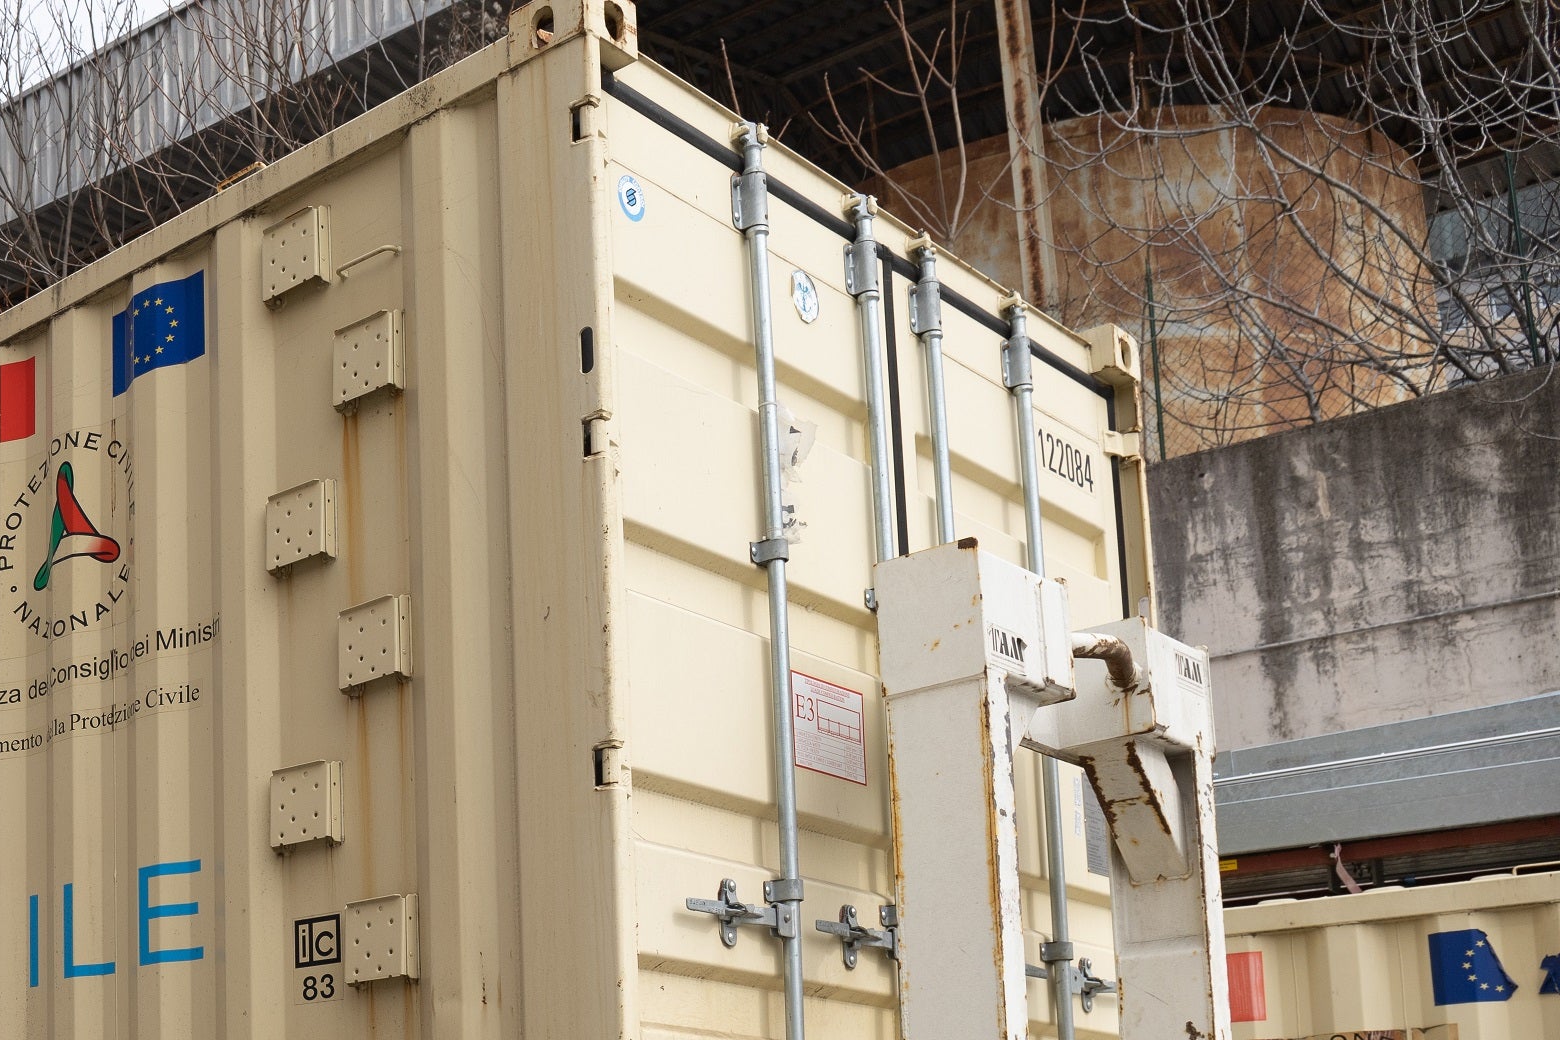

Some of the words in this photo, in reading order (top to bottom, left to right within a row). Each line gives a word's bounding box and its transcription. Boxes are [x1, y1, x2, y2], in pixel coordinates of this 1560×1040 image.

[1037, 428, 1094, 493] 122084
[13, 564, 130, 640] NAZIONALE
[145, 684, 200, 709] Civile
[795, 693, 815, 722] E3
[302, 973, 335, 1001] 83
